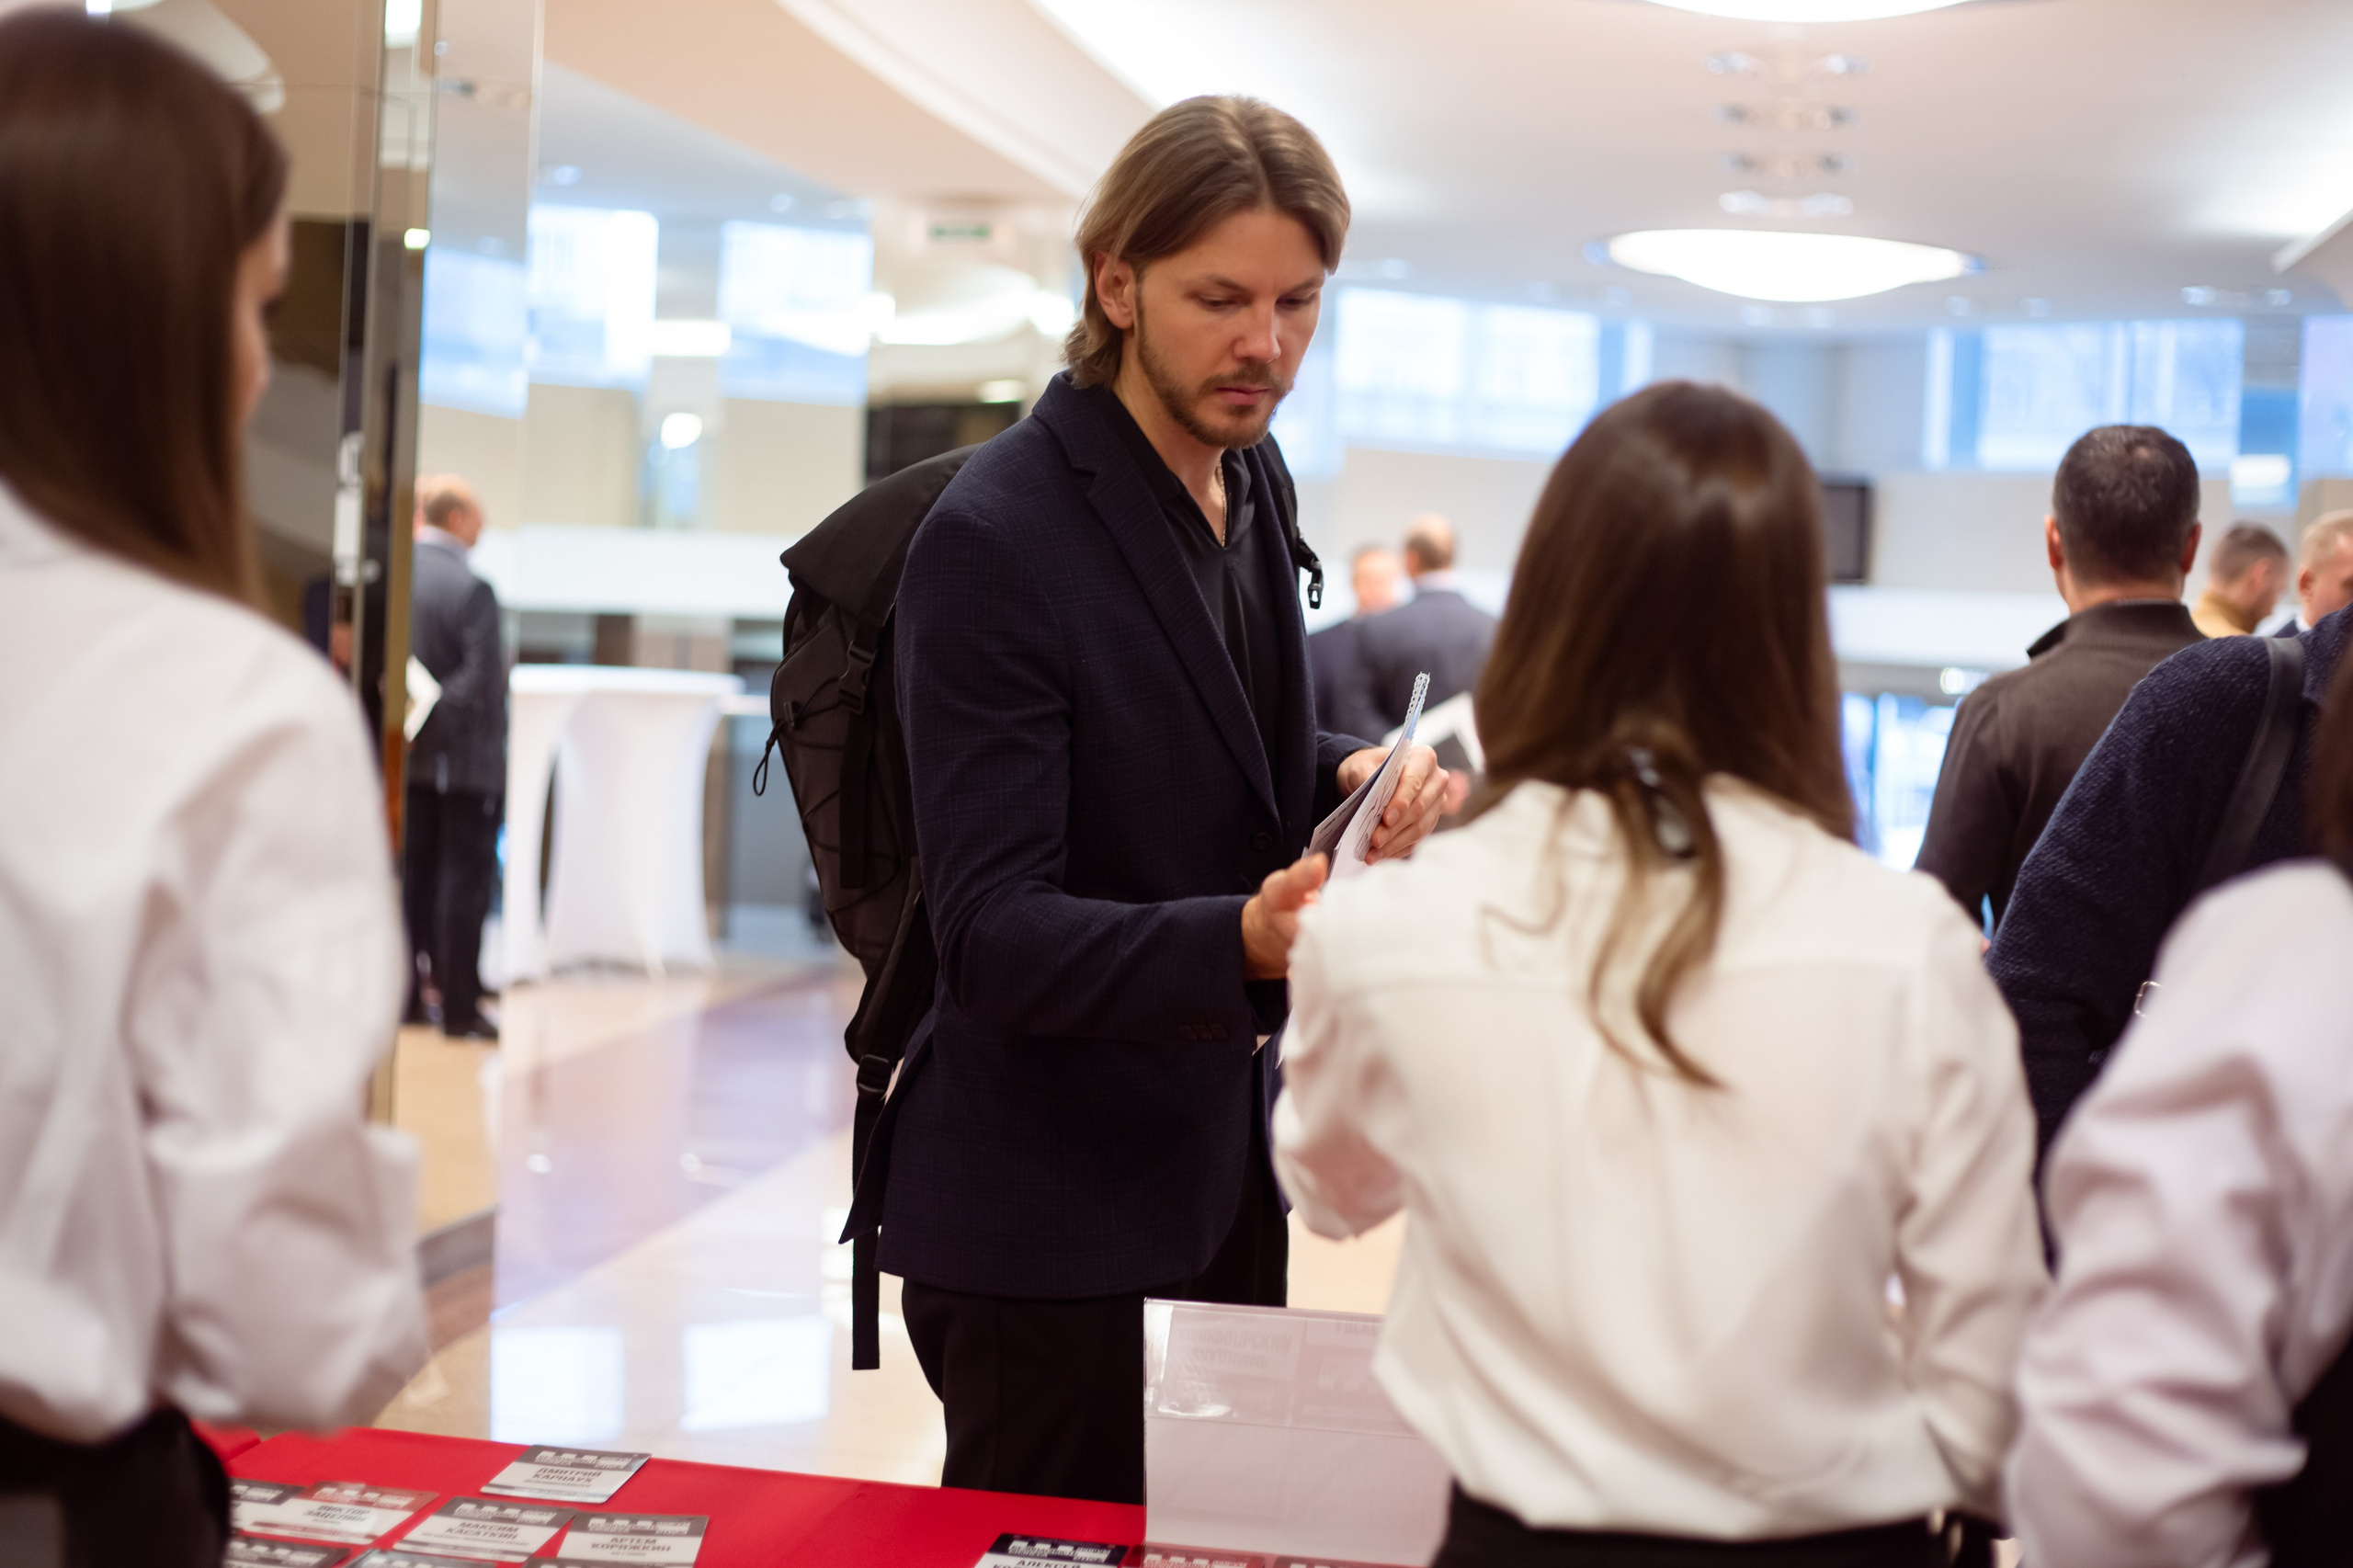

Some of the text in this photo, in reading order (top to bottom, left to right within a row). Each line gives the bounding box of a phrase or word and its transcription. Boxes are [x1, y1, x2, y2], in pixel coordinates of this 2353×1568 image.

[532, 1473, 594, 1483] КАРНАУХ
[538, 1467, 602, 1478] ДМИТРИЙ
[303, 1510, 367, 1522] ЗАЦЕПИН
[317, 1505, 370, 1516] ВИКТОР
[459, 1521, 519, 1533] МАКСИМ
[445, 1528, 518, 1540] КАСАТКИН
[591, 1542, 671, 1551] КОРЯЖКИН
[610, 1537, 658, 1545] АРТЕМ
